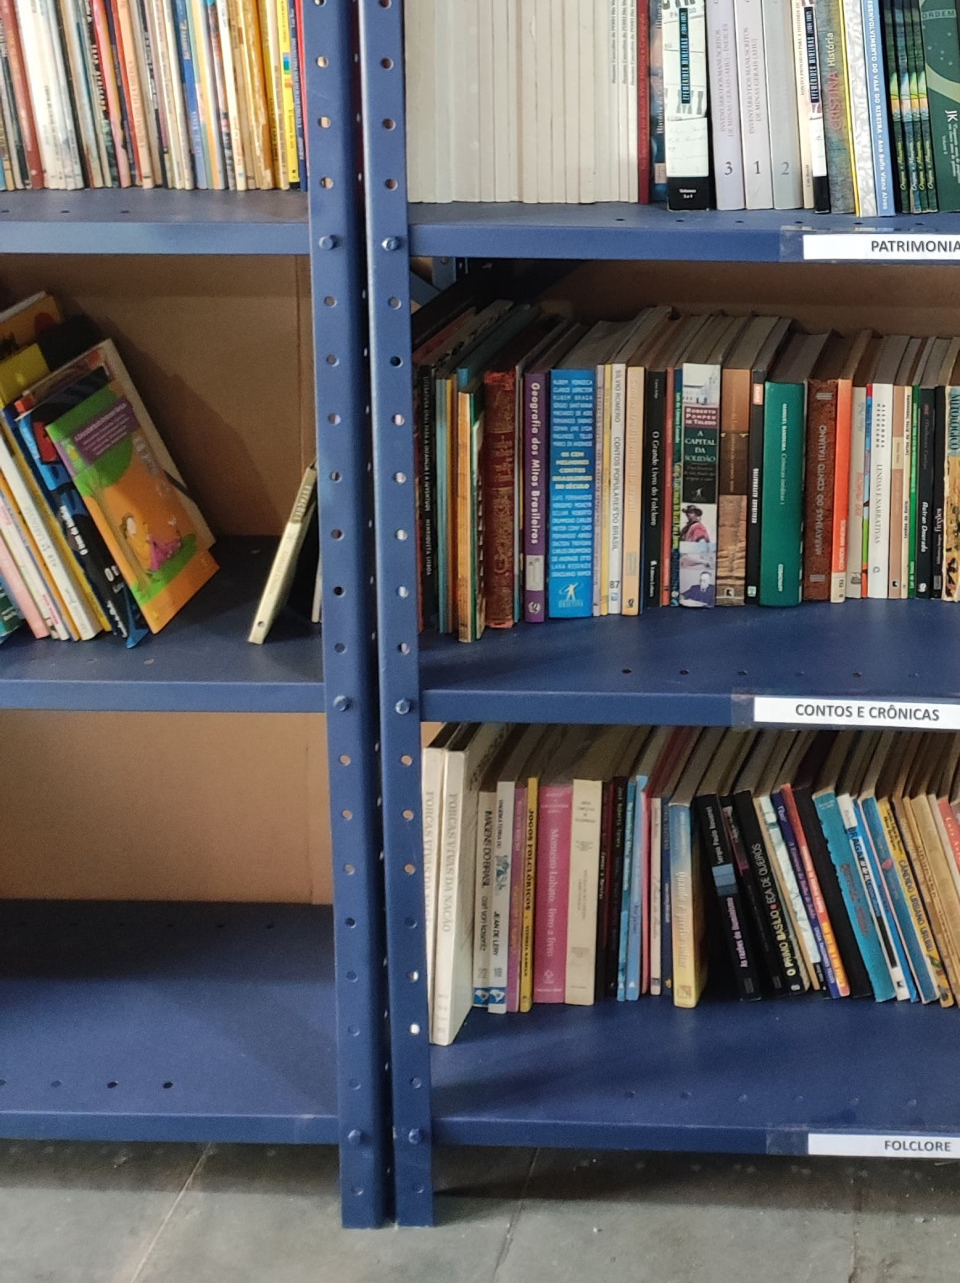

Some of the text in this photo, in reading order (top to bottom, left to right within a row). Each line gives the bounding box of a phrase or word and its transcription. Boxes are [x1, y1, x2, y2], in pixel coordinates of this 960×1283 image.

[871, 63, 878, 73] DO
[824, 32, 841, 130] CRISTINA História
[873, 93, 880, 103] DO
[874, 105, 882, 133] RIBEIRA
[945, 110, 958, 121] JK
[725, 161, 733, 175] 3
[755, 161, 761, 174] 1
[782, 161, 790, 175] 2
[879, 171, 887, 189] Viana
[650, 440, 659, 465] Grande
[528, 382, 541, 543] Geografia dos Mitos Brasileiros
[650, 467, 658, 484] Livro
[650, 486, 658, 495] do
[609, 580, 620, 589] 87
[796, 705, 940, 721] CONTOS E CRÔNICAS
[750, 843, 776, 904] EÇA DE QUEIRÓS
[898, 858, 934, 952] CÂNDIDO URBANO URUBU
[768, 908, 796, 976] O PRIMO BASÍLIO
[884, 1140, 951, 1152] FOLCLORE
